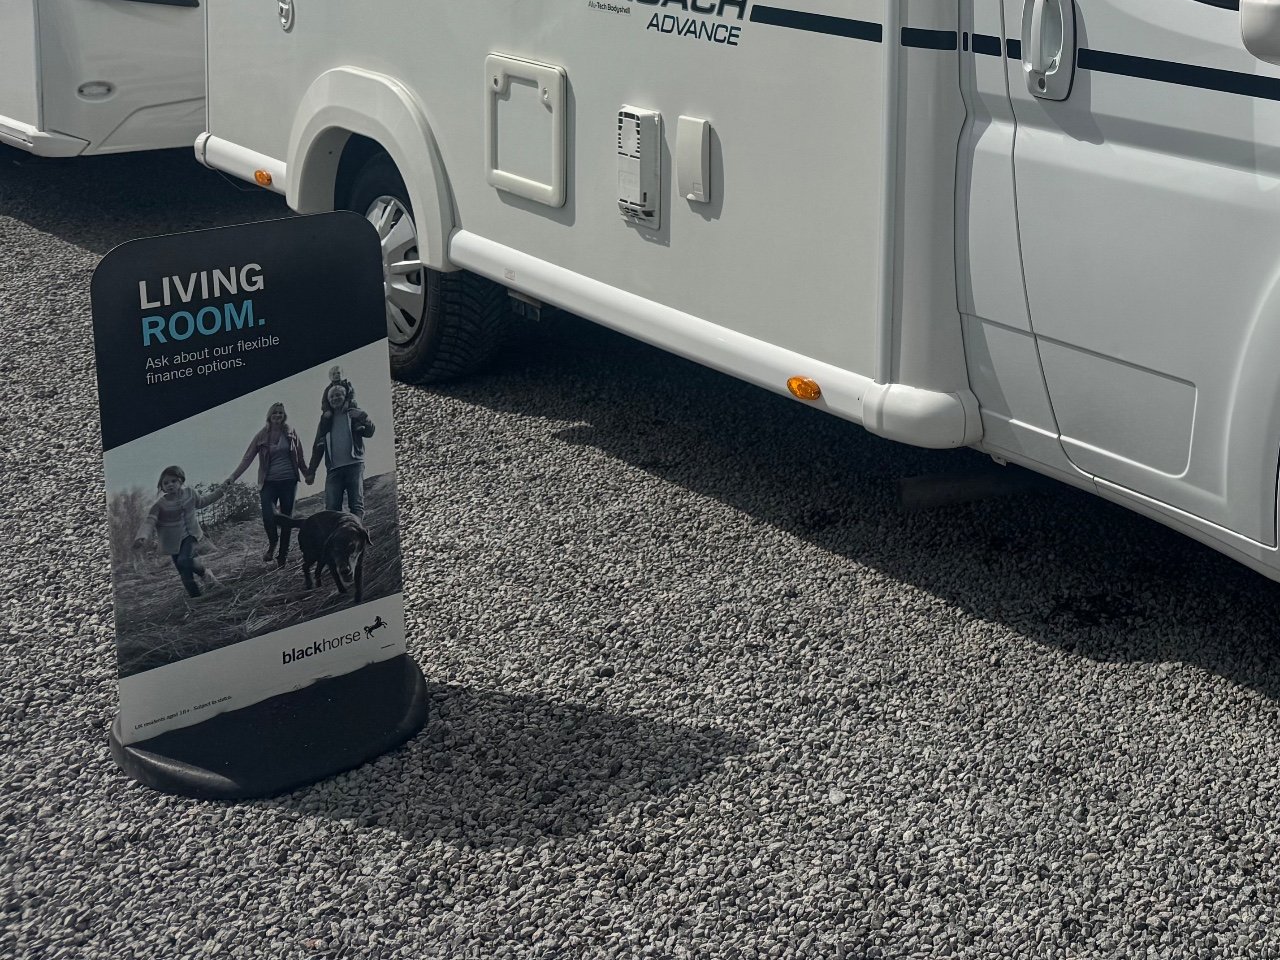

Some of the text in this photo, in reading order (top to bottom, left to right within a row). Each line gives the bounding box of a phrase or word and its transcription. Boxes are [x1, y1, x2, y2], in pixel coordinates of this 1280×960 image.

[646, 12, 742, 46] ADVANCE
[138, 262, 265, 310] LIVING
[141, 299, 266, 346] ROOM.
[145, 334, 280, 370] Ask about our flexible
[146, 357, 246, 385] finance options.
[282, 630, 361, 665] blackhorse
